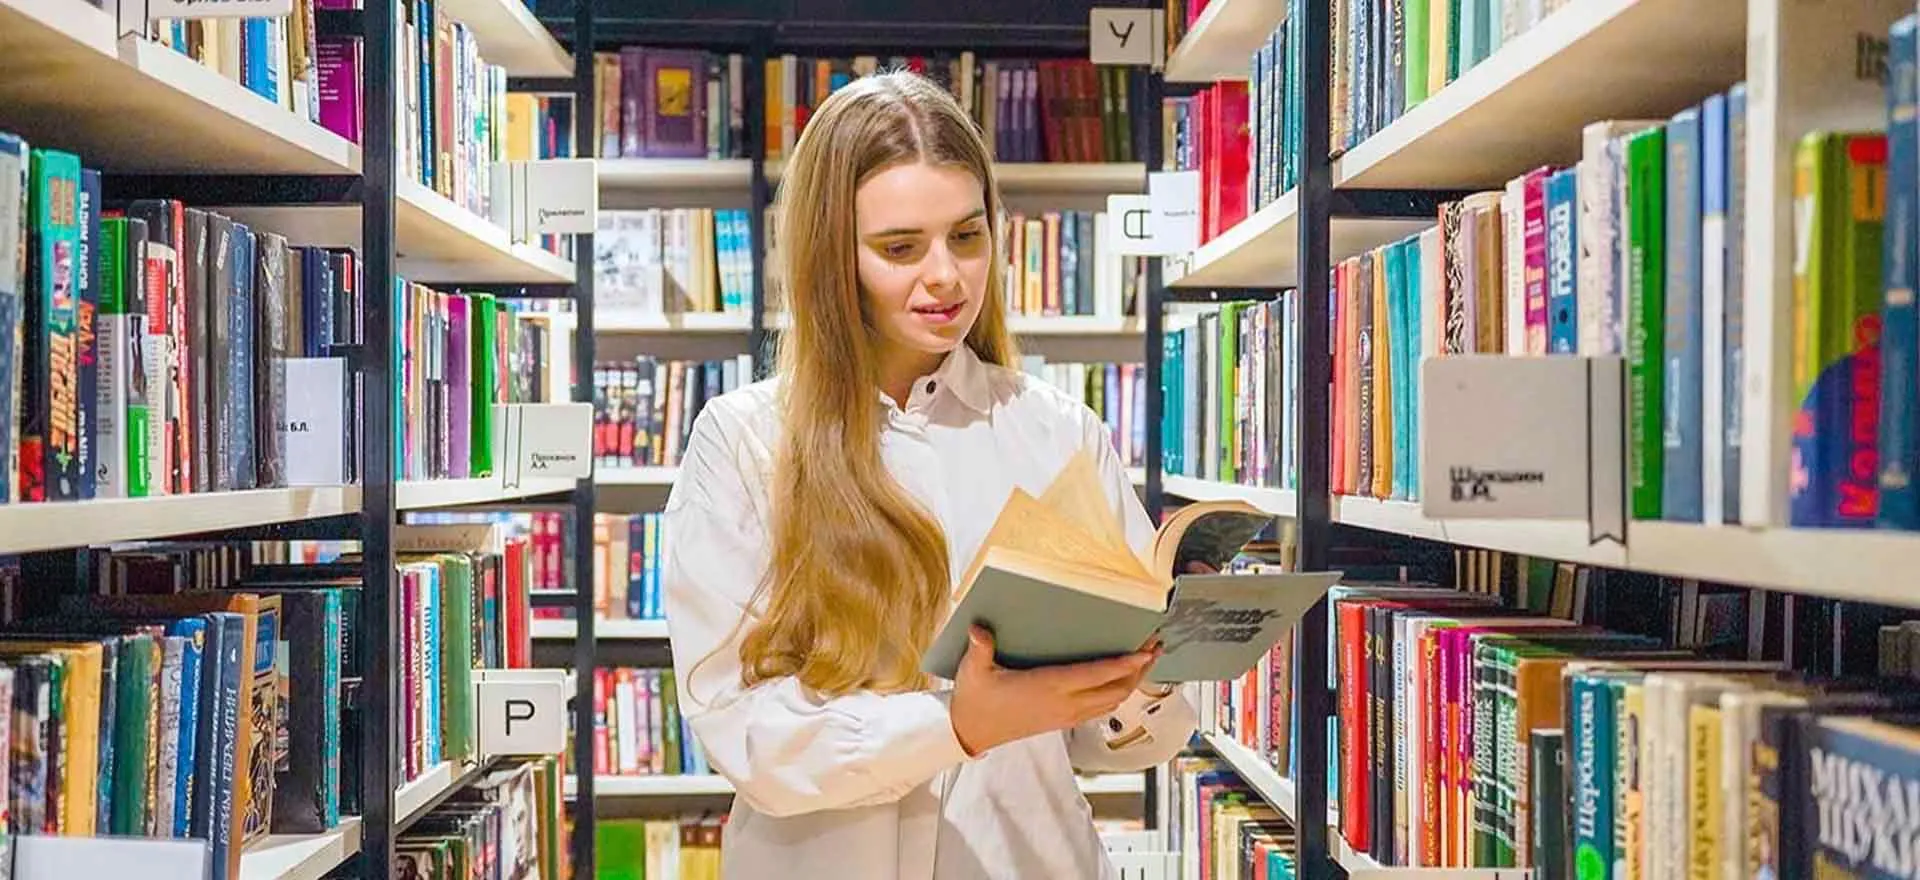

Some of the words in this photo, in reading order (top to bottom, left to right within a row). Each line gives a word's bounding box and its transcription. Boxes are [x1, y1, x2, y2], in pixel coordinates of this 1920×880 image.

[1109, 20, 1135, 48] У
[1449, 466, 1543, 483] Шукшин
[504, 699, 535, 736] Р
[1579, 691, 1600, 838] Щербакова
